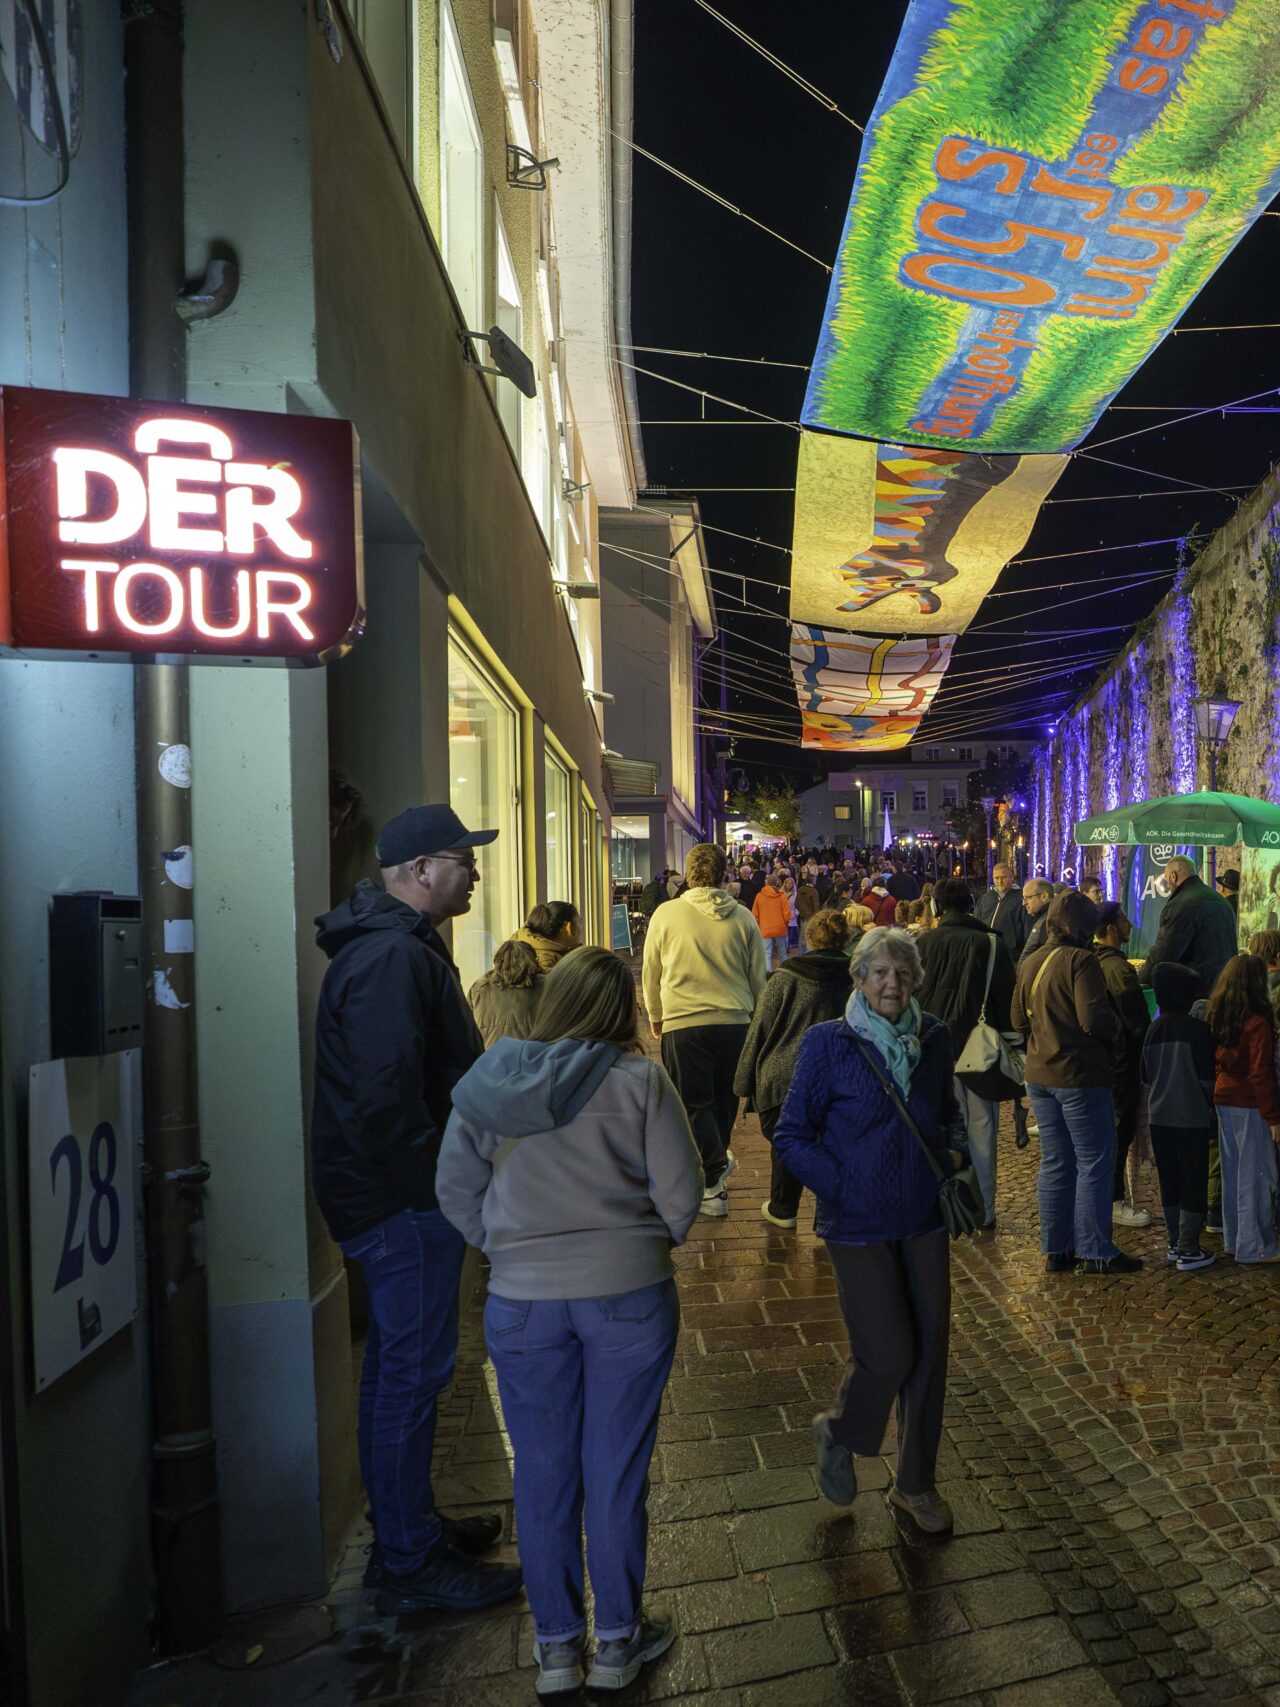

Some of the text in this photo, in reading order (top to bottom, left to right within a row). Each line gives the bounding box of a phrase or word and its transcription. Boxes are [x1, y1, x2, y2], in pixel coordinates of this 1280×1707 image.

[1066, 133, 1118, 181] est
[911, 309, 1034, 439] ist hoffnung
[54, 446, 314, 559] DER
[60, 559, 315, 641] TOUR
[1089, 827, 1109, 840] AOK
[1140, 873, 1172, 901] AO
[49, 1120, 120, 1293] 28
